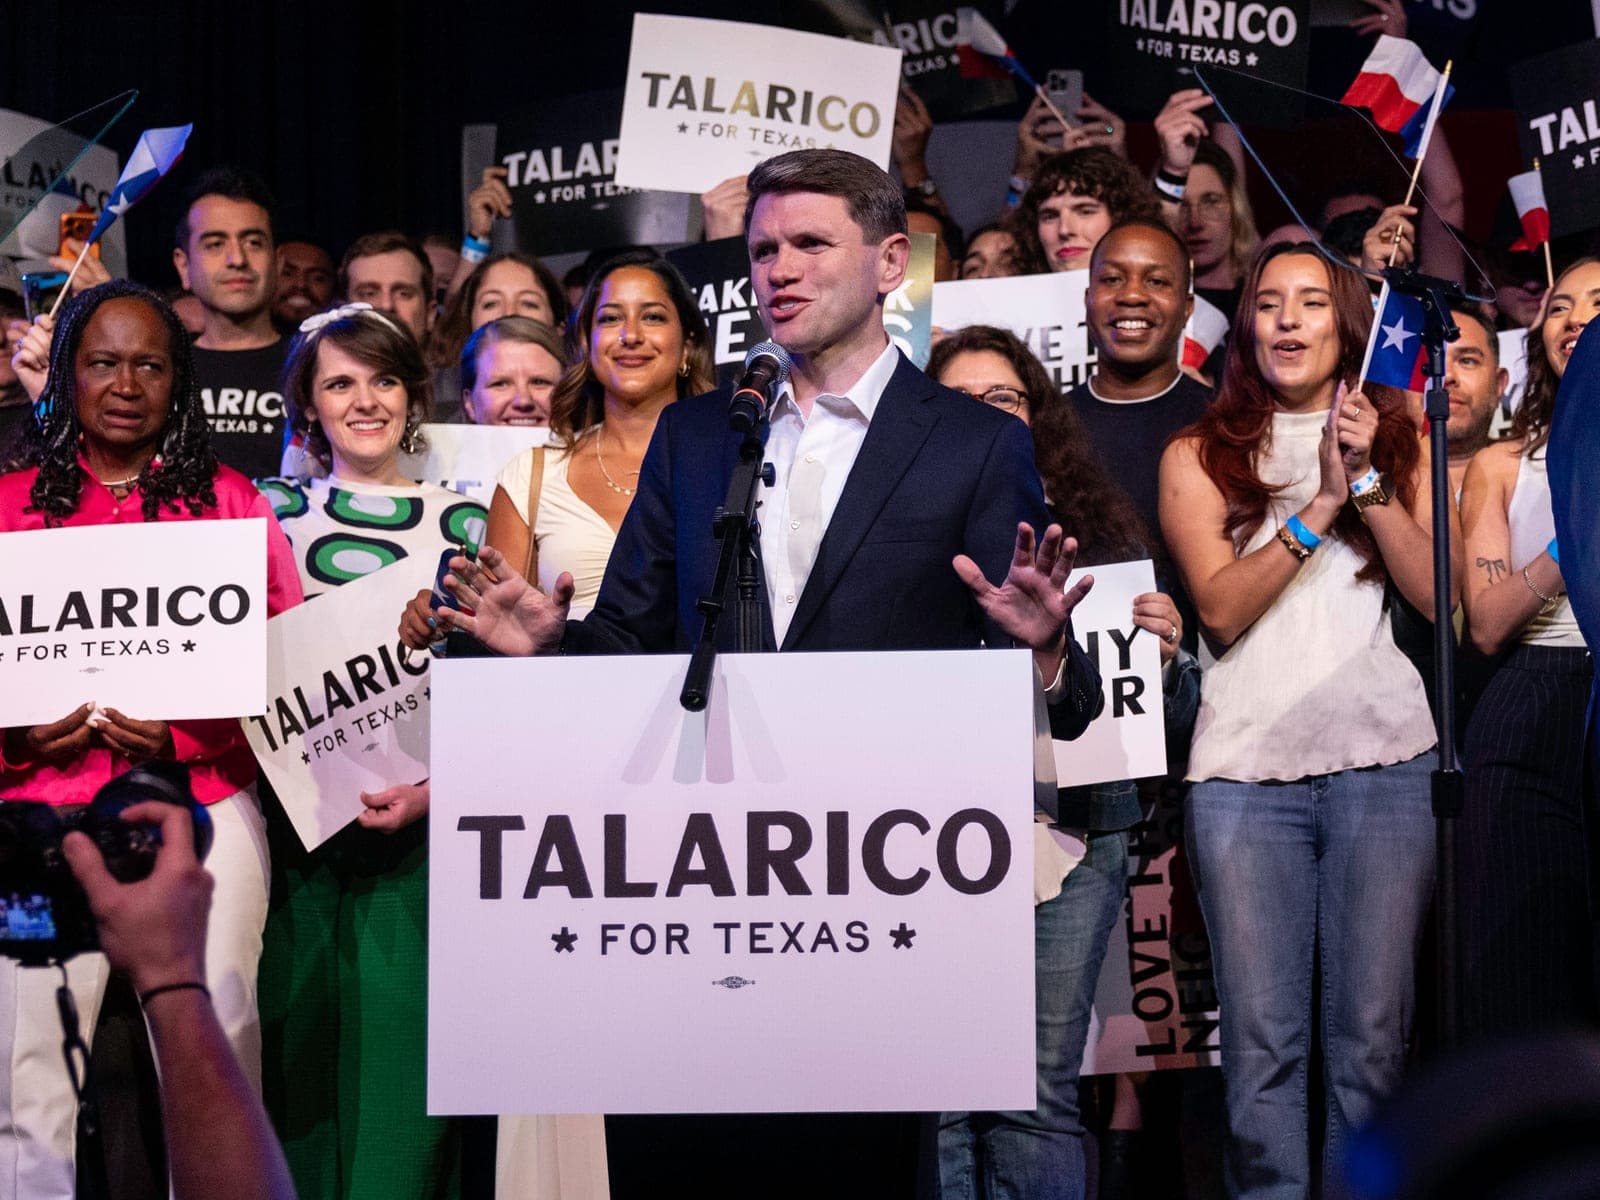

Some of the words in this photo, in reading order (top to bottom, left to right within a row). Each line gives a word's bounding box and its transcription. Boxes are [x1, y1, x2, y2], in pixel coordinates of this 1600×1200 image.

[1147, 39, 1173, 58] FOR
[1178, 44, 1240, 66] TEXAS
[641, 71, 881, 139] TALARICO
[698, 122, 738, 140] FOR
[551, 184, 586, 203] FOR
[591, 181, 646, 198] TEX
[17, 643, 68, 662] FOR
[81, 638, 171, 657] TEXAS
[313, 727, 349, 759] FOR
[352, 693, 419, 736] TEXAS
[457, 807, 1012, 900] TALARICO
[601, 923, 691, 956] FOR
[713, 920, 870, 954] TEXAS
[1126, 912, 1177, 1058] LOVE
